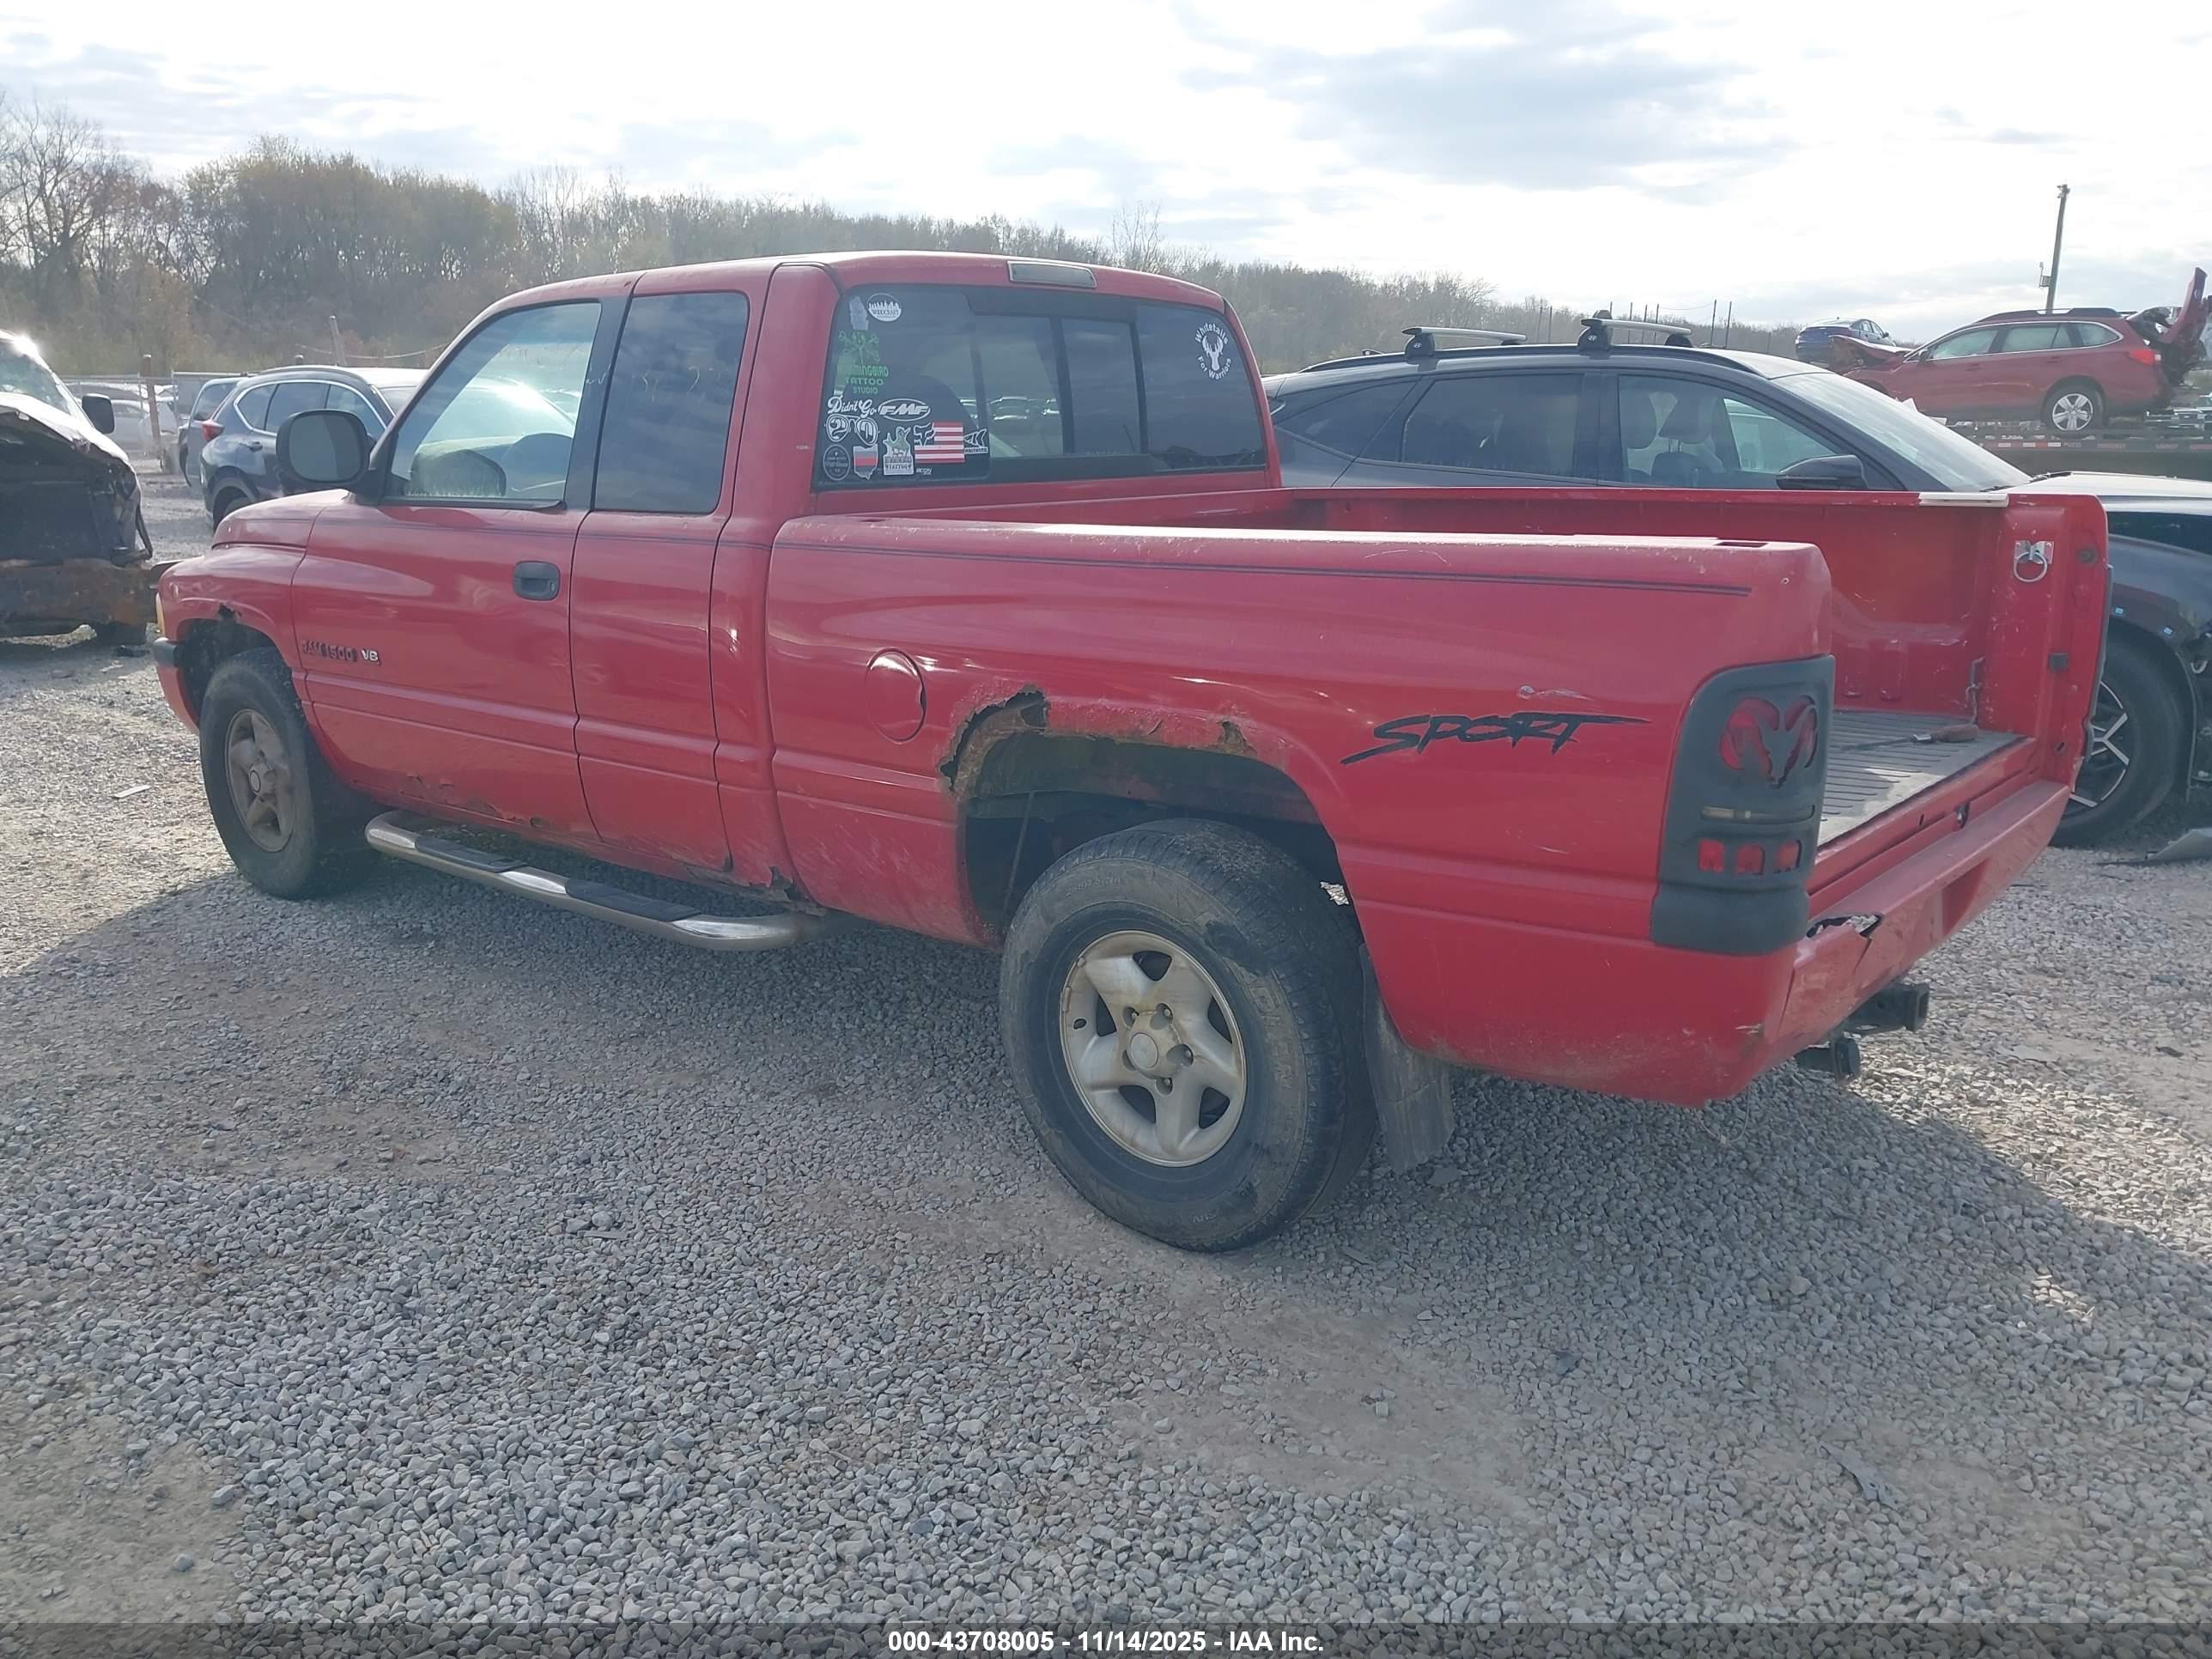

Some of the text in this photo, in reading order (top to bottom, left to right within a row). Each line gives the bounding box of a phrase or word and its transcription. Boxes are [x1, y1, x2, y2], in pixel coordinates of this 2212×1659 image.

[1194, 322, 1229, 343] Whitetails
[1197, 356, 1231, 380] For Warriors
[846, 376, 884, 386] TATTOO
[852, 386, 878, 395] STUDIO
[878, 403, 929, 416] FMF
[1340, 711, 1652, 765] SPORT
